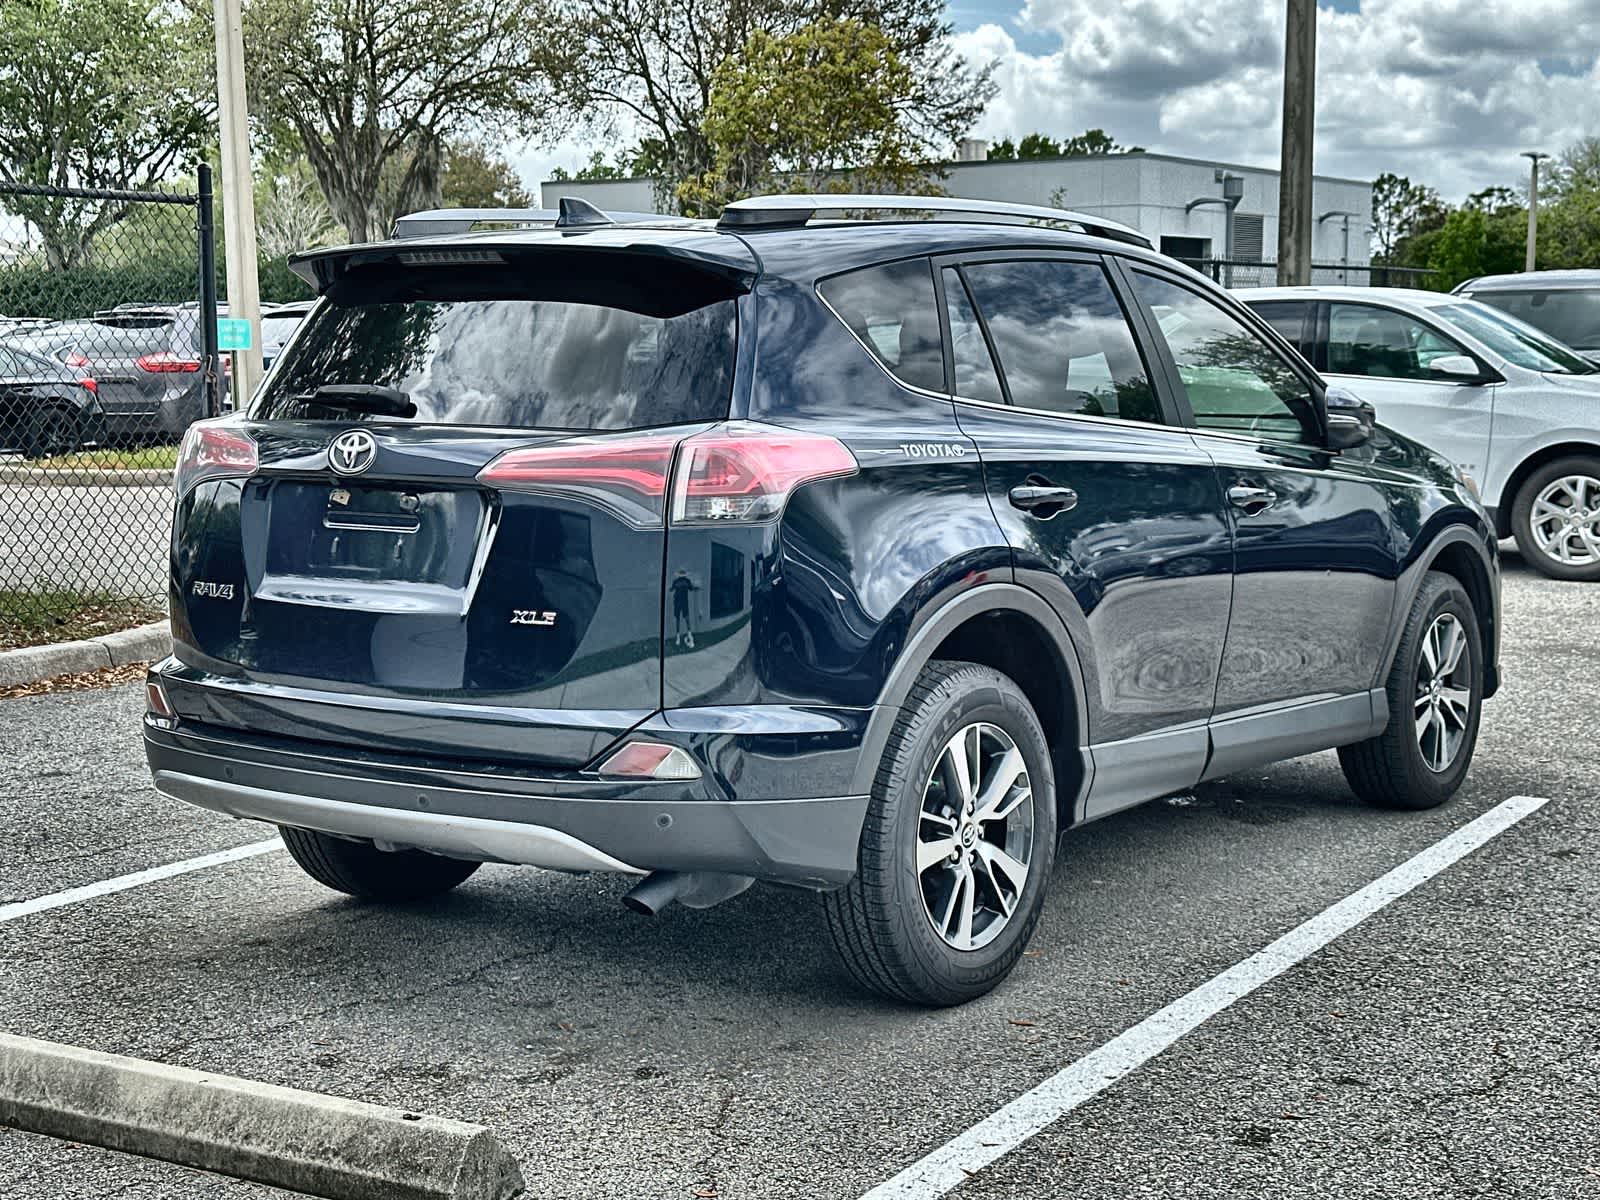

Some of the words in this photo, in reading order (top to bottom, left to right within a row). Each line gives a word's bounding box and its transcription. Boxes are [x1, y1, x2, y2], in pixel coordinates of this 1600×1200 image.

[900, 443, 954, 457] TOYOTA
[192, 580, 234, 600] RAV4
[509, 609, 557, 625] XLE
